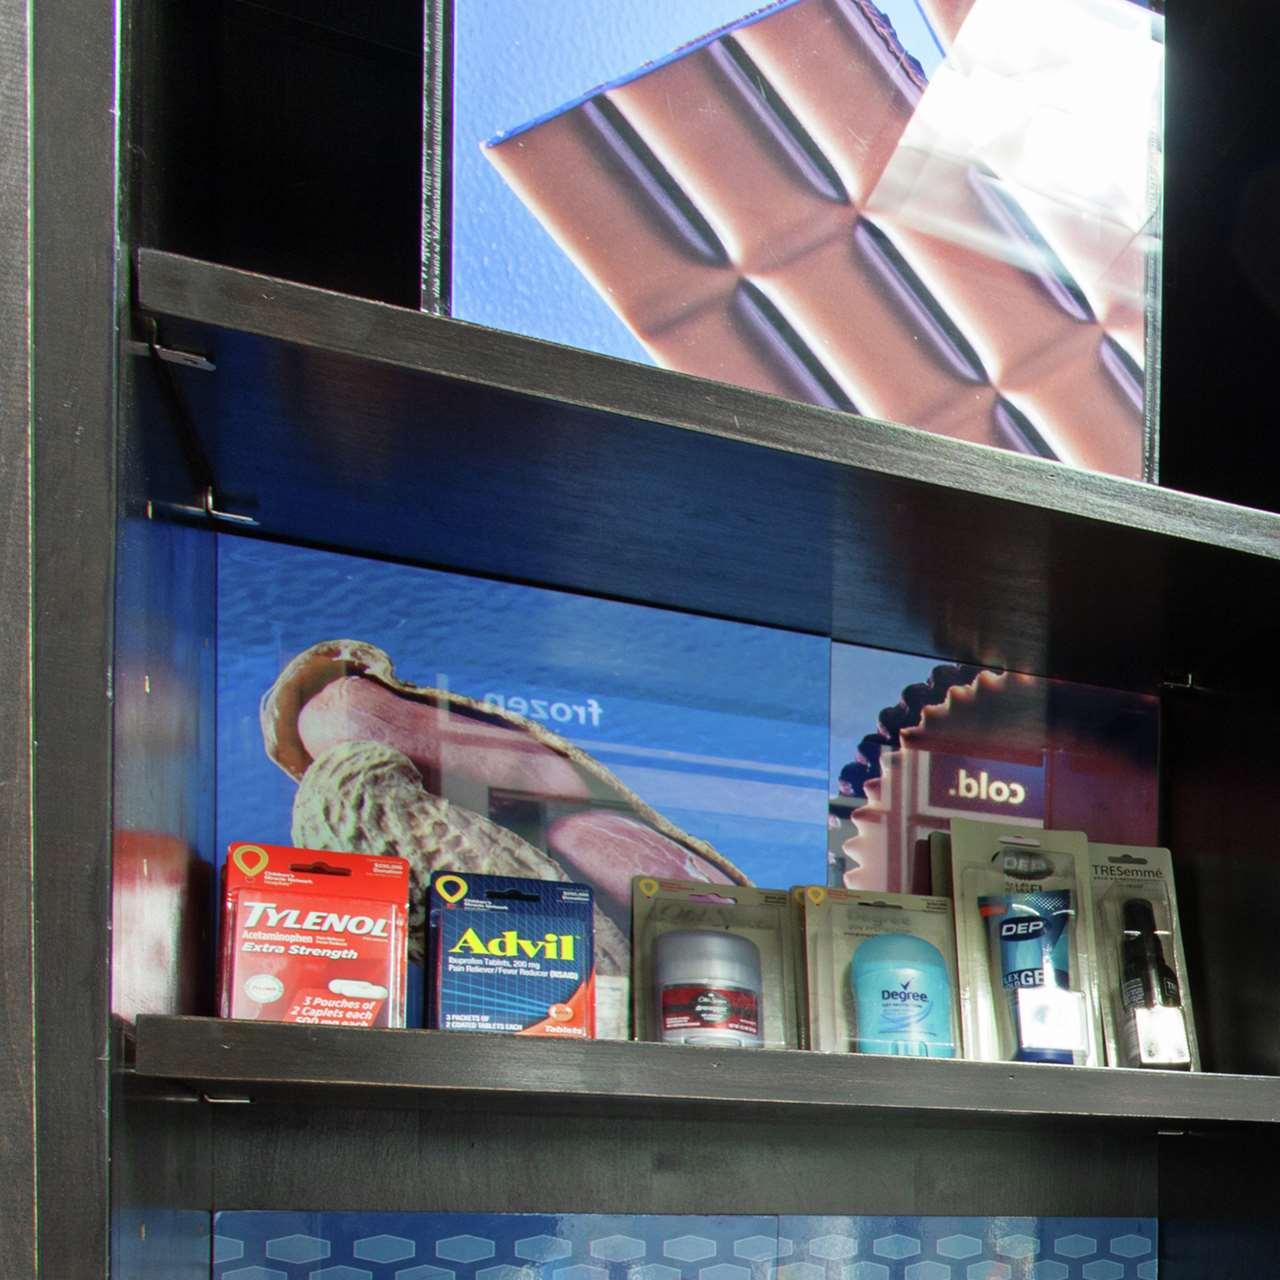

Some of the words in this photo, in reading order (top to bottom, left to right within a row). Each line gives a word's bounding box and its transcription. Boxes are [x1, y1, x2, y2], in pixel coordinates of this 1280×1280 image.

[1092, 864, 1163, 878] TRESemmé
[243, 901, 389, 937] TYLENOL
[1001, 921, 1044, 935] DEP
[242, 930, 313, 944] Acetaminophen
[241, 942, 285, 954] Extra
[288, 945, 358, 960] Strength
[448, 928, 575, 961] Advil
[881, 989, 928, 1002] Degree
[312, 997, 360, 1010] Pouches
[362, 1001, 376, 1010] of
[291, 1006, 299, 1015] 2
[302, 1006, 344, 1019] Caplets
[346, 1009, 373, 1020] each
